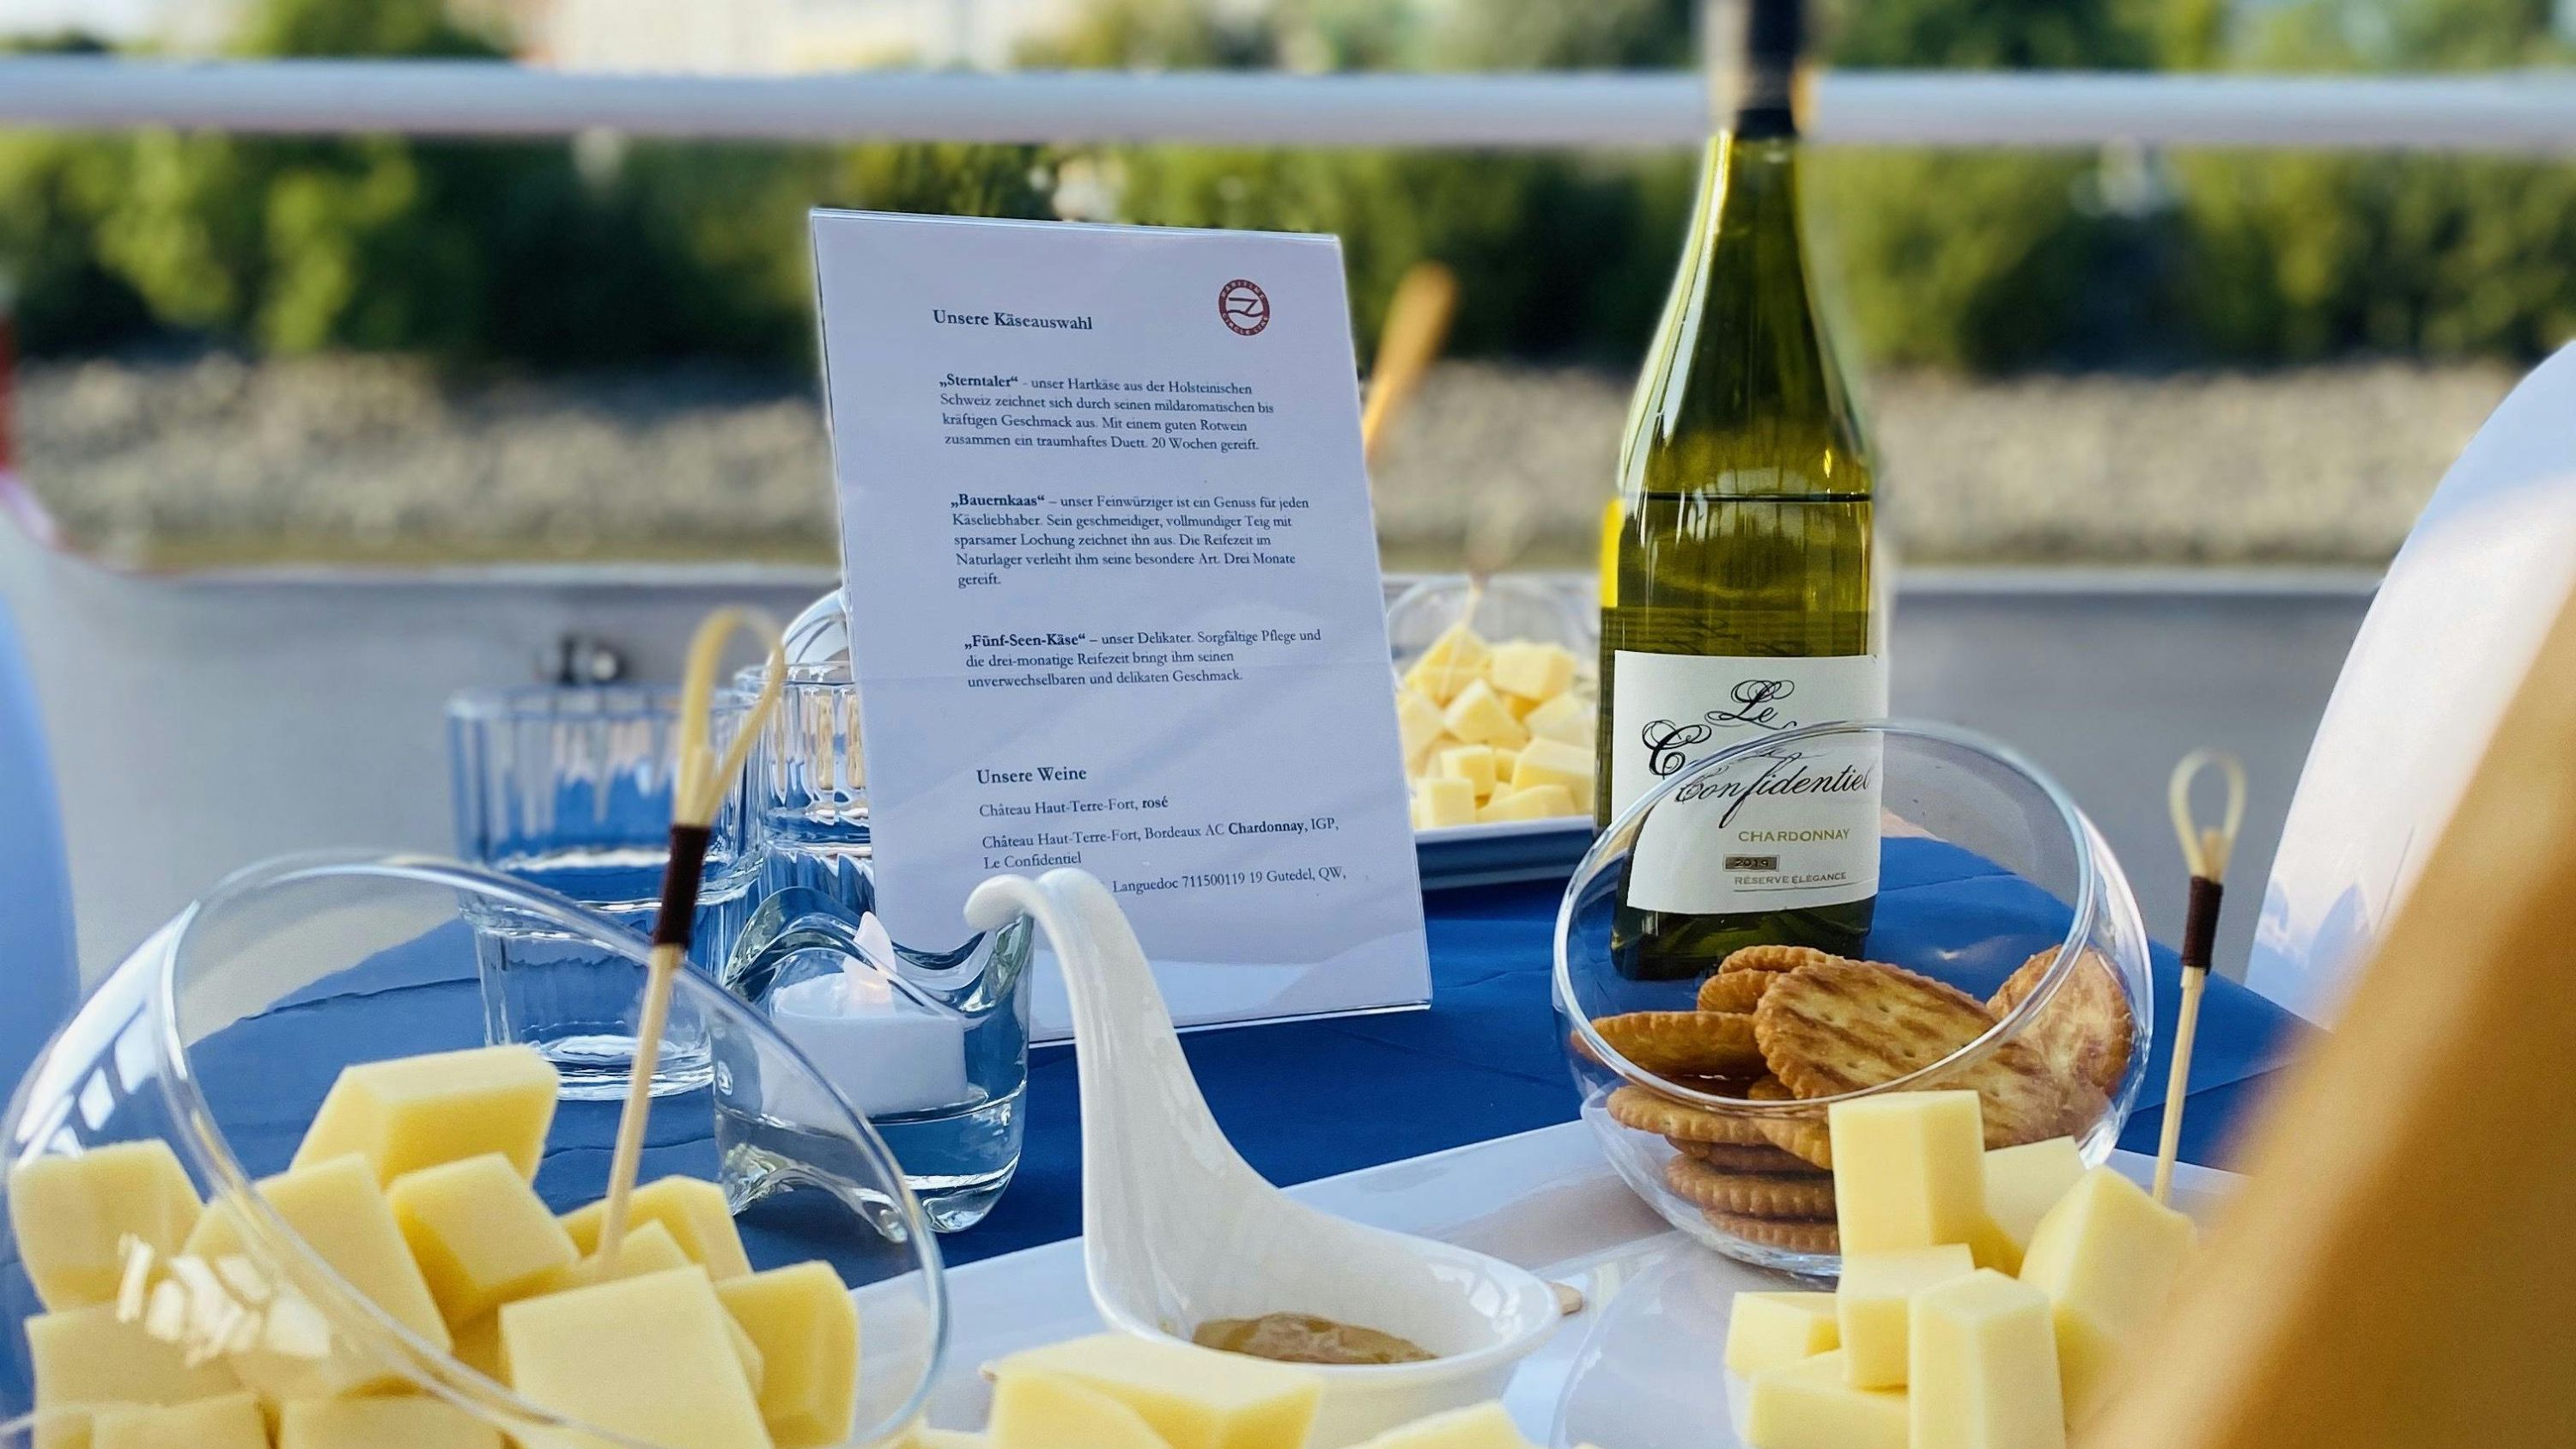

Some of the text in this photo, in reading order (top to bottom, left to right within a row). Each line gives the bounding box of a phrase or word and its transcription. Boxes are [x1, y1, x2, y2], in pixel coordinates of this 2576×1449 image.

[933, 309, 1092, 330] Unsere Käseauswahl
[1031, 381, 1064, 389] unser
[1067, 378, 1121, 391] Hartkäse
[1146, 381, 1164, 392] der
[1169, 381, 1252, 394] Holsteinischen
[941, 393, 1273, 413] Schweiz zeichnet sich durch seinen mildaromatischen bis
[942, 412, 998, 429] kräftigen
[1001, 415, 1072, 427] Geschmack
[1102, 417, 1122, 429] Mit
[1126, 417, 1161, 429] einem
[1164, 419, 1196, 434] guten
[1200, 419, 1247, 431] Rotwein
[945, 436, 1011, 446] zusammen
[1015, 435, 1033, 446] ein
[1036, 435, 1107, 447] traumhaftes
[1151, 437, 1165, 448] 20
[1169, 437, 1217, 449] Wochen
[1221, 439, 1259, 454] gereift.
[1097, 495, 1173, 511] Feinwürziger
[1177, 496, 1190, 508] ist
[1194, 496, 1210, 508] ein
[1214, 496, 1256, 508] Genuss
[1261, 496, 1276, 508] für
[1279, 496, 1309, 511] jeden
[1047, 514, 1072, 526] Sein
[1077, 514, 1163, 530] geschmeidiger,
[1166, 514, 1242, 530] vollmundiger
[1244, 515, 1270, 530] Teig
[1273, 515, 1291, 527] mit
[955, 537, 1017, 550] sparsamer
[1021, 533, 1075, 550] Lochung
[1078, 533, 1128, 545] zeichnet
[1131, 533, 1150, 545] ihn
[1179, 534, 1200, 545] Die
[1203, 533, 1254, 545] Reifezeit
[956, 553, 1022, 569] Naturlager
[1025, 552, 1072, 564] verleiht
[1075, 553, 1098, 565] ihm
[1103, 553, 1132, 564] seine
[1135, 552, 1194, 564] besondere
[1224, 551, 1250, 564] Drei
[1252, 551, 1295, 564] Monate
[957, 573, 1001, 589] gereift.
[1198, 630, 1258, 646] Sorgfältige
[1261, 630, 1296, 645] Pflege
[1299, 629, 1321, 641] und
[966, 650, 1234, 669] die drei-monatige Reifezeit bringt ihm seinen
[968, 668, 1242, 687] unverwechselbaren und delikaten Geschmack.
[1704, 679, 1797, 730] Le
[976, 766, 1086, 784] Unsere Weine
[980, 795, 1168, 817] Château Haut-Terre-Fort, rosé
[982, 818, 1339, 849] Château Haut-Terre-Fort, Bordeaux AC Chardonnay, IGP,
[1738, 829, 1850, 843] CHARDONNAY
[984, 851, 1081, 869] Le Confidentiel
[1735, 858, 1769, 868] 2019
[1113, 866, 1346, 895] Languedoc 711500119 19 Gutedel, QW,
